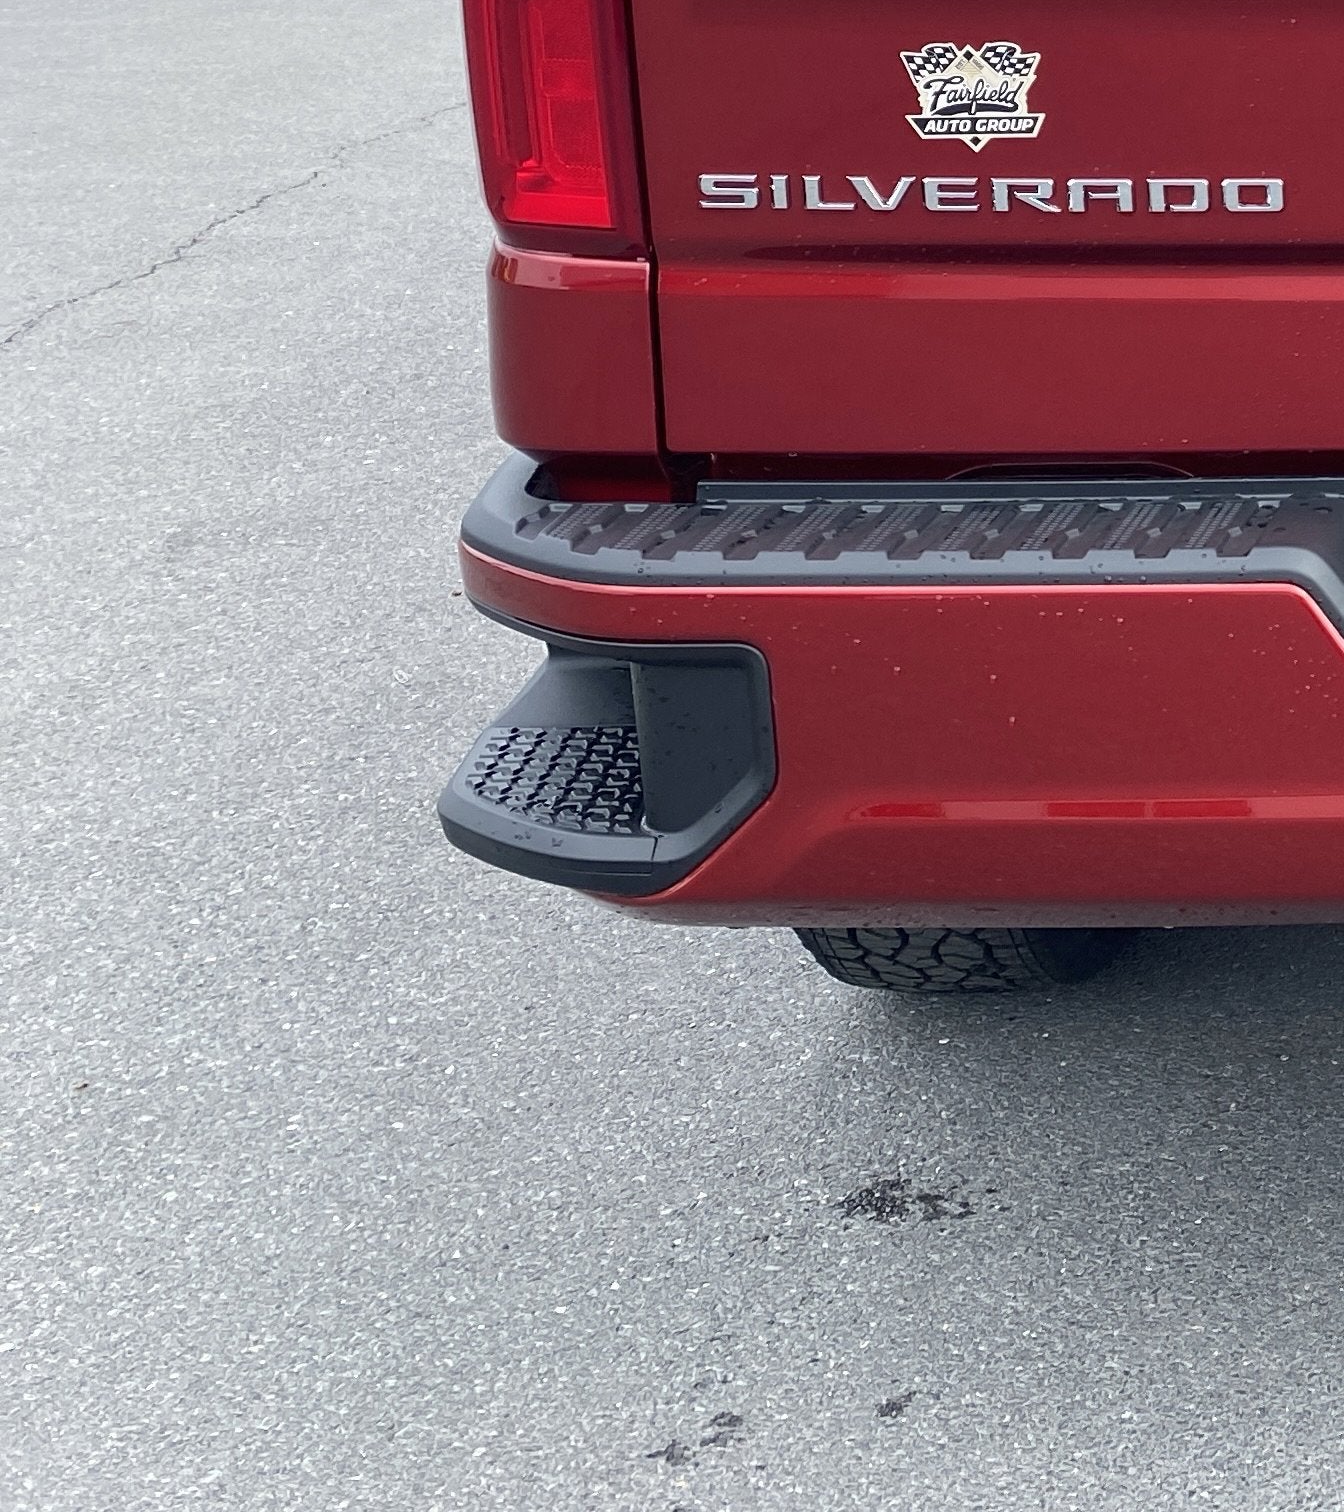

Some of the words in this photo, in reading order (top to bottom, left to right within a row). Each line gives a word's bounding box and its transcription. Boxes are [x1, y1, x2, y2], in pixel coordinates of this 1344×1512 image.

[923, 76, 1025, 115] Fairfield
[924, 119, 972, 133] AUTO
[975, 119, 1034, 133] GROUP
[699, 173, 1286, 213] SILVERADO
